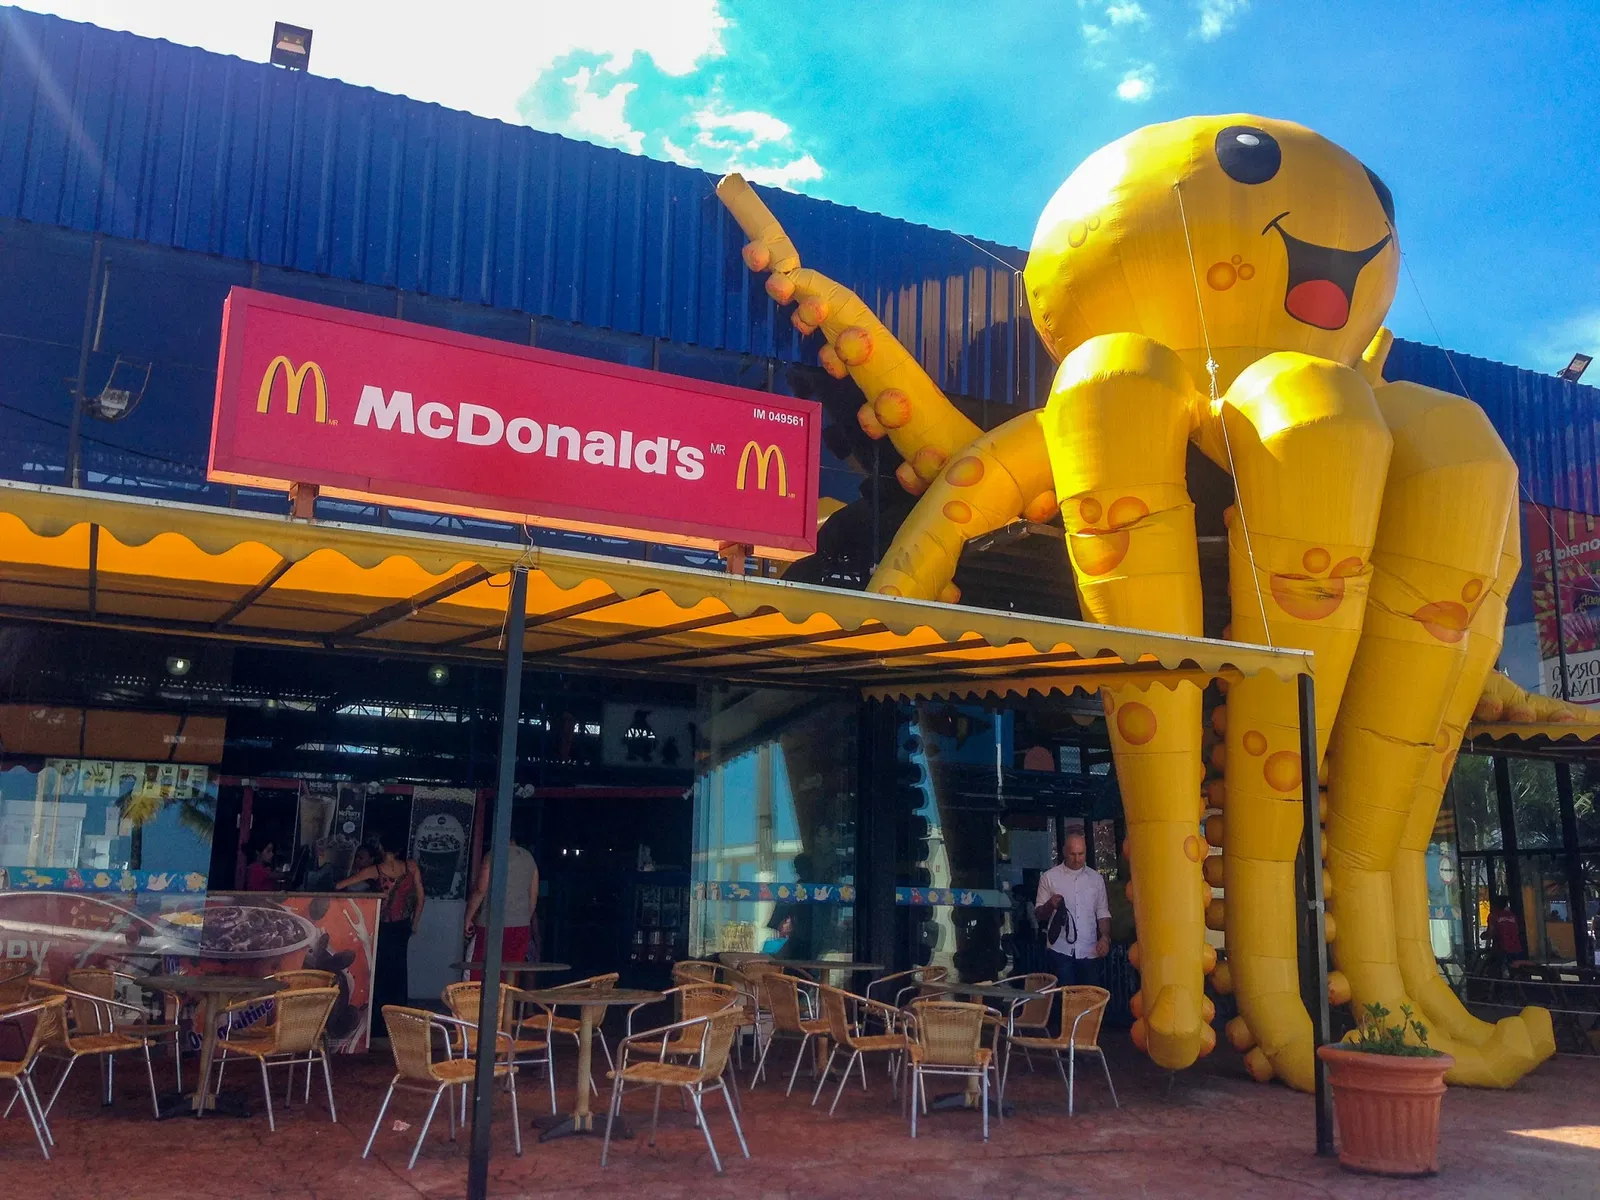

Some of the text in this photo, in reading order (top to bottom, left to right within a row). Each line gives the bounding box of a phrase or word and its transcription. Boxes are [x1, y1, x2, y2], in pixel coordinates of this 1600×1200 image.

[353, 384, 726, 481] McDonald's MR
[753, 408, 804, 427] IM 049561
